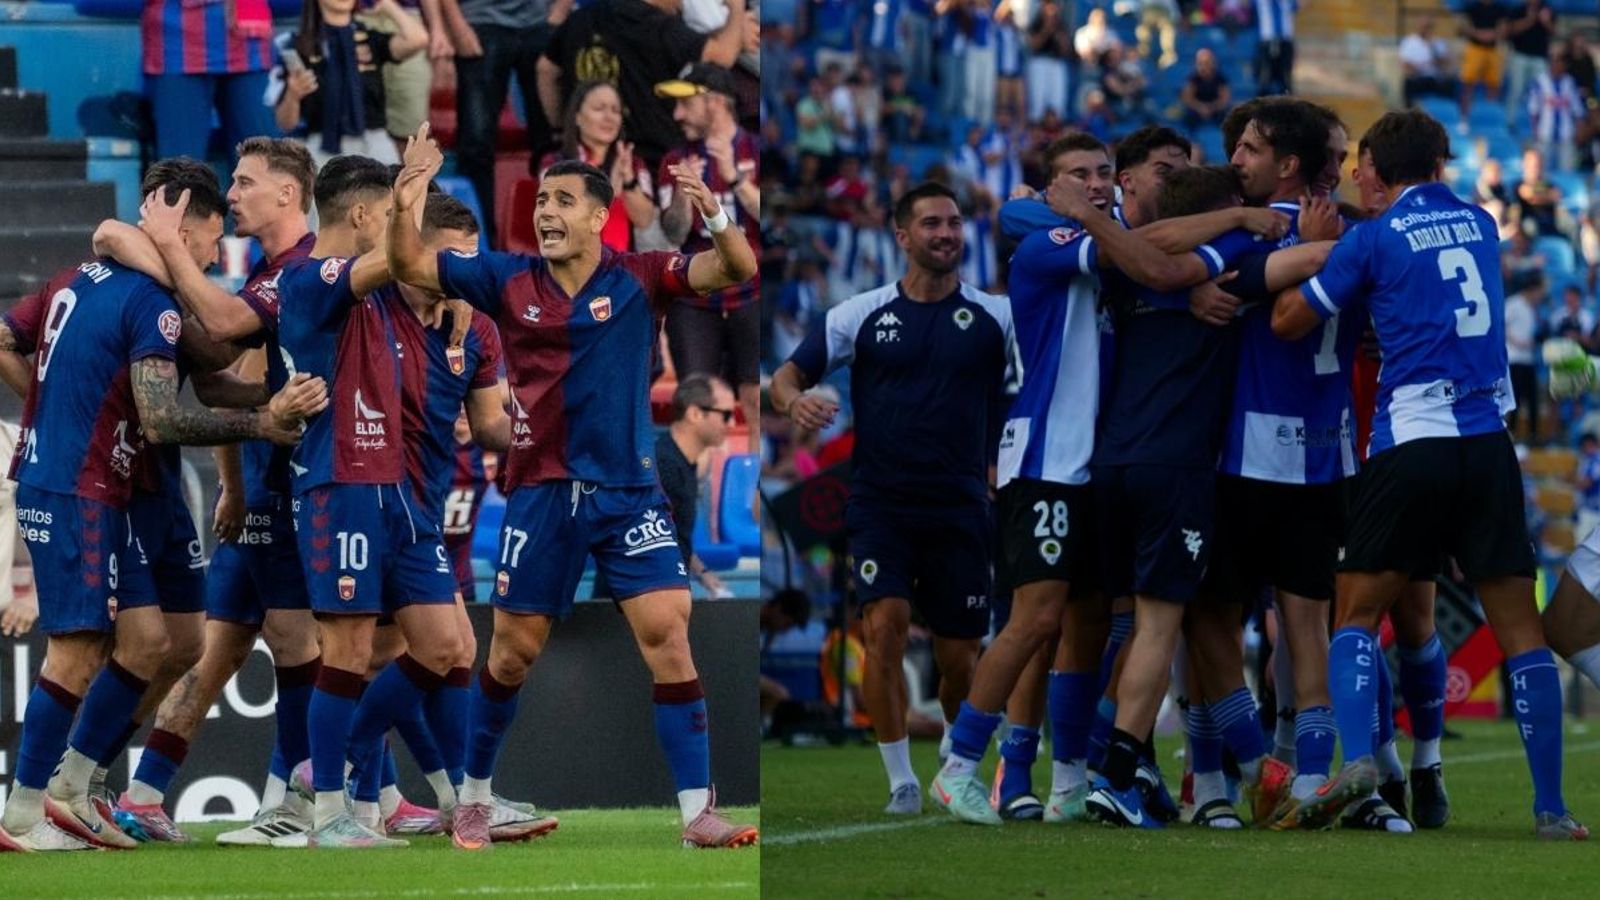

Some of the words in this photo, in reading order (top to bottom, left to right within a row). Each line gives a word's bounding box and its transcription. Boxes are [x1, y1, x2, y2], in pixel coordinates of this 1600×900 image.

[1437, 247, 1492, 337] 3
[37, 288, 77, 382] 9
[876, 329, 901, 343] P.F.
[355, 422, 386, 435] ELDA
[624, 518, 672, 547] CRC
[1033, 500, 1069, 537] 28
[336, 531, 368, 570] 10
[501, 525, 528, 568] 17
[108, 552, 118, 590] 9
